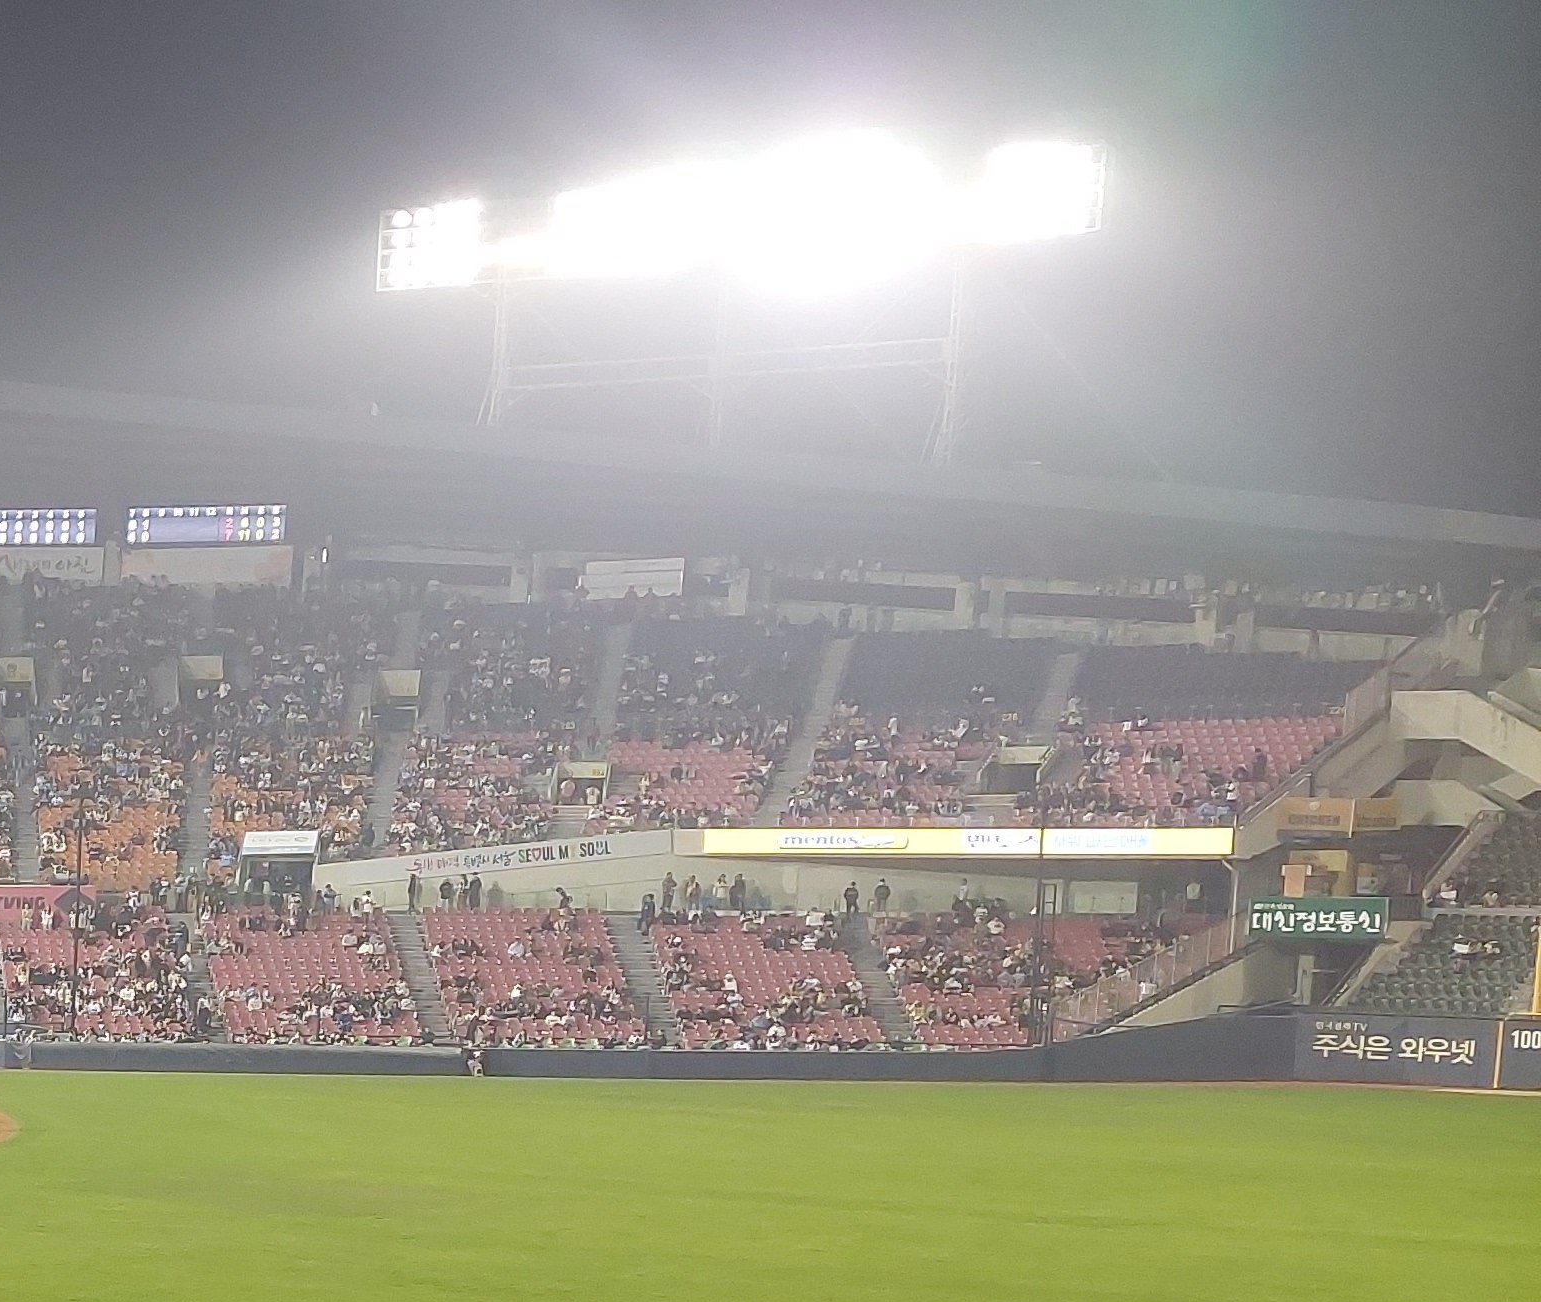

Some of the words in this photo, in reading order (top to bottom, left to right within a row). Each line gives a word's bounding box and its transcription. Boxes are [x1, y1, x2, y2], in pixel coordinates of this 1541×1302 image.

[1251, 910, 1381, 933] 대신정보통신
[1312, 1034, 1393, 1060] 주식은
[1398, 1037, 1476, 1065] 와우넷
[1511, 1029, 1541, 1049] 100
